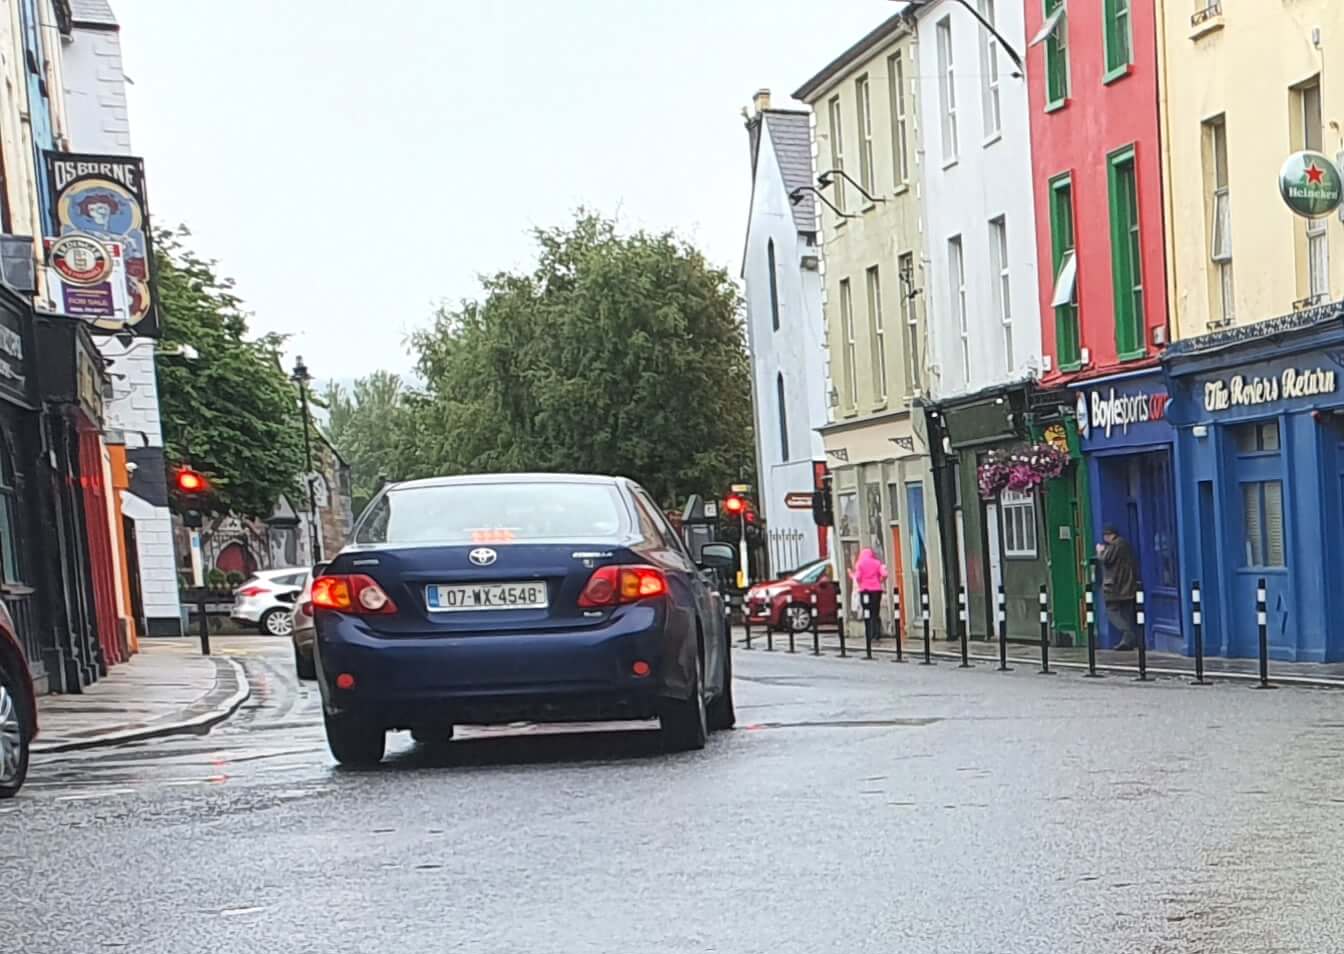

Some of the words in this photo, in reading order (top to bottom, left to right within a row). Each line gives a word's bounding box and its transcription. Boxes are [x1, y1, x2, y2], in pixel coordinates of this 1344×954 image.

[54, 161, 138, 194] OSBORNE
[1288, 186, 1338, 200] Heineken
[1204, 379, 1229, 411] The
[1230, 375, 1279, 406] Rovers
[1281, 367, 1336, 399] Return
[447, 587, 537, 606] 07-WX-4548
